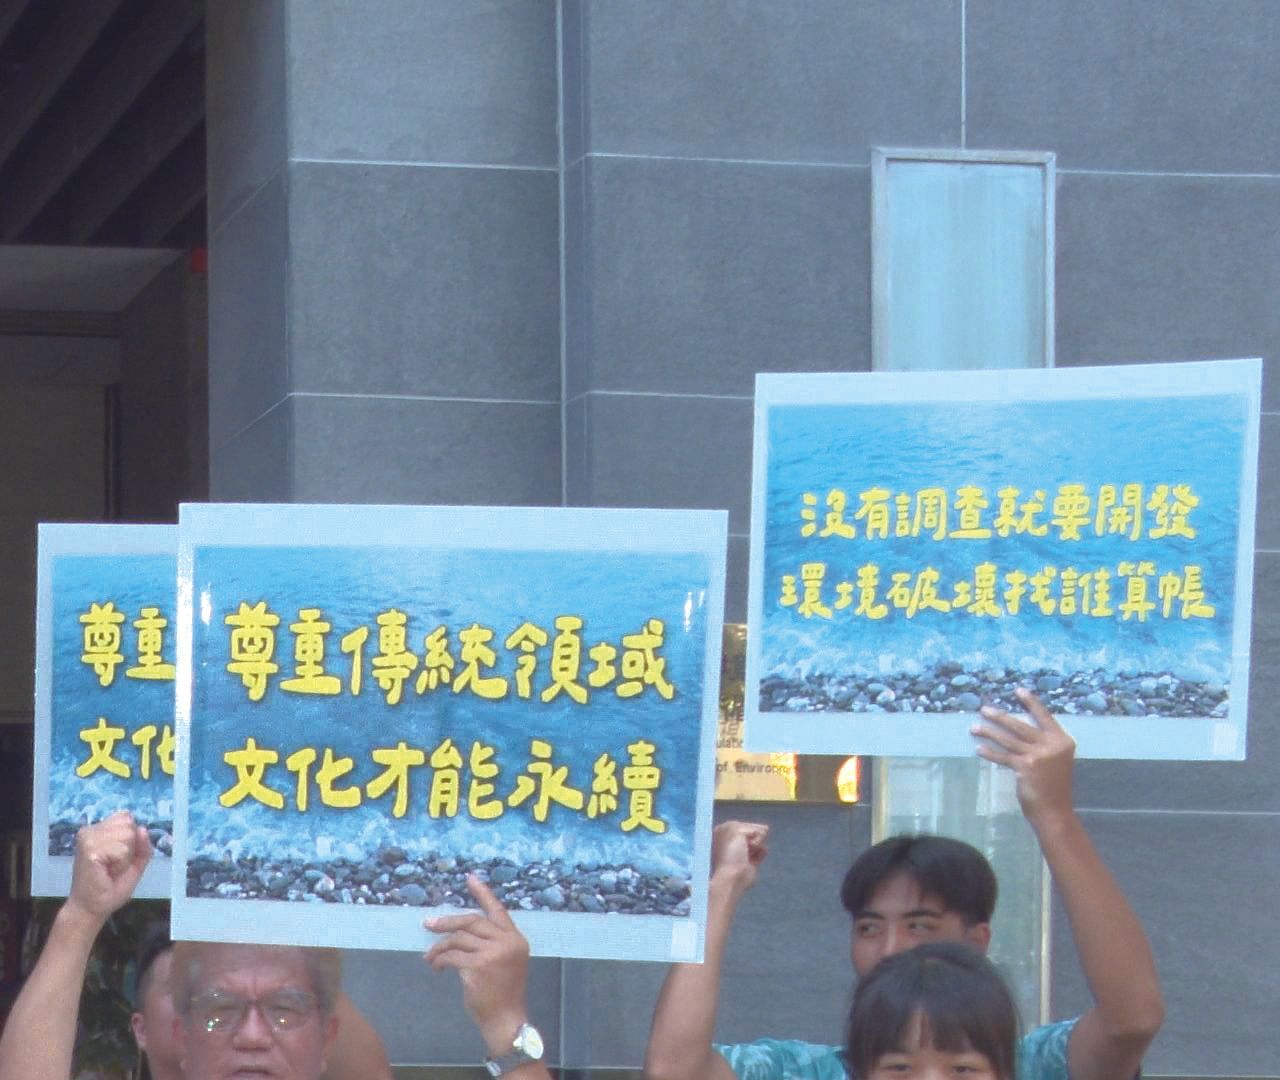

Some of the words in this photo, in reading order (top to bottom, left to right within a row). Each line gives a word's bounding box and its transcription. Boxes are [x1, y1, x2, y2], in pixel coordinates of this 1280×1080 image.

[799, 483, 1200, 542] 沒有調查就要開發
[779, 561, 1217, 622] 環境破壞找誰算帳
[79, 602, 175, 688] 尊重
[224, 601, 676, 706] 尊重傳統領域
[76, 717, 175, 780] 文化
[219, 739, 668, 835] 文化才能永續
